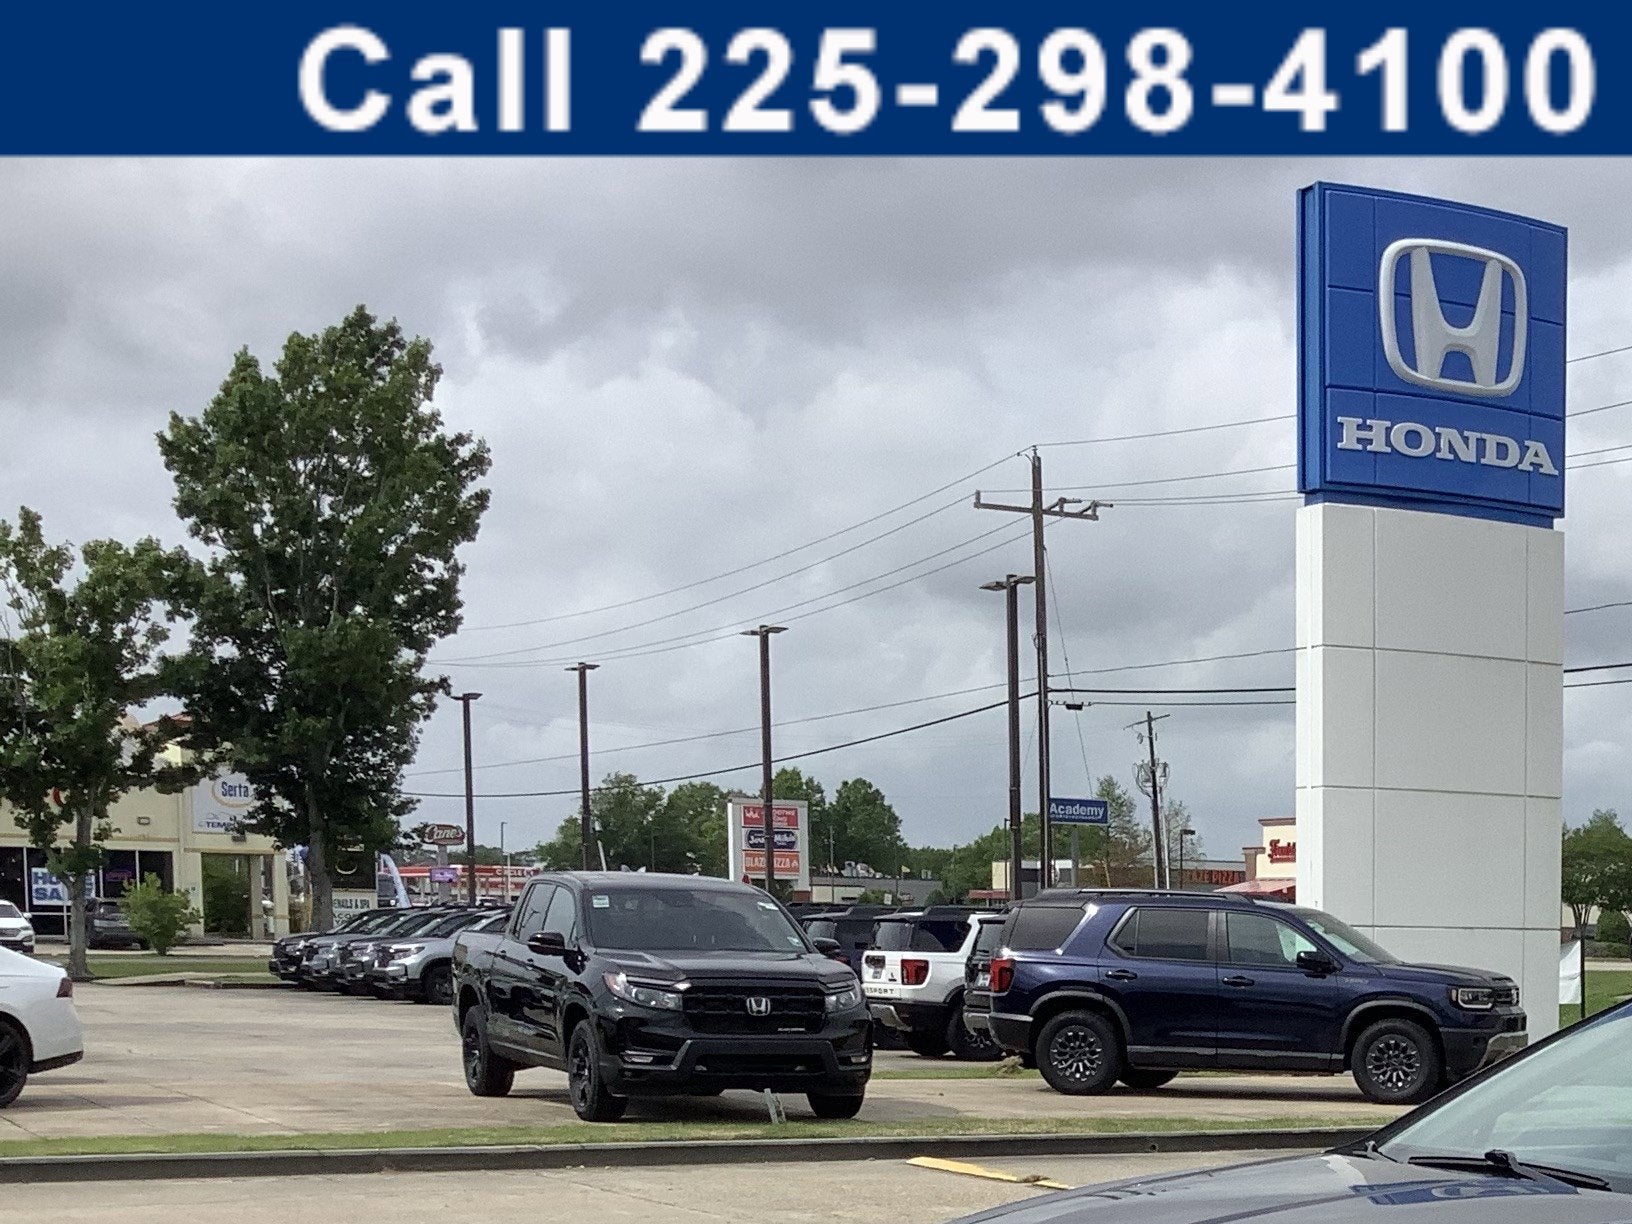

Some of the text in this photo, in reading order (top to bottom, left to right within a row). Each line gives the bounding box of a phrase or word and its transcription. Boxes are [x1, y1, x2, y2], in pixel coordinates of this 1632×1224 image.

[1336, 415, 1559, 476] HONDA
[221, 781, 249, 798] Serta
[1049, 802, 1105, 819] Academy
